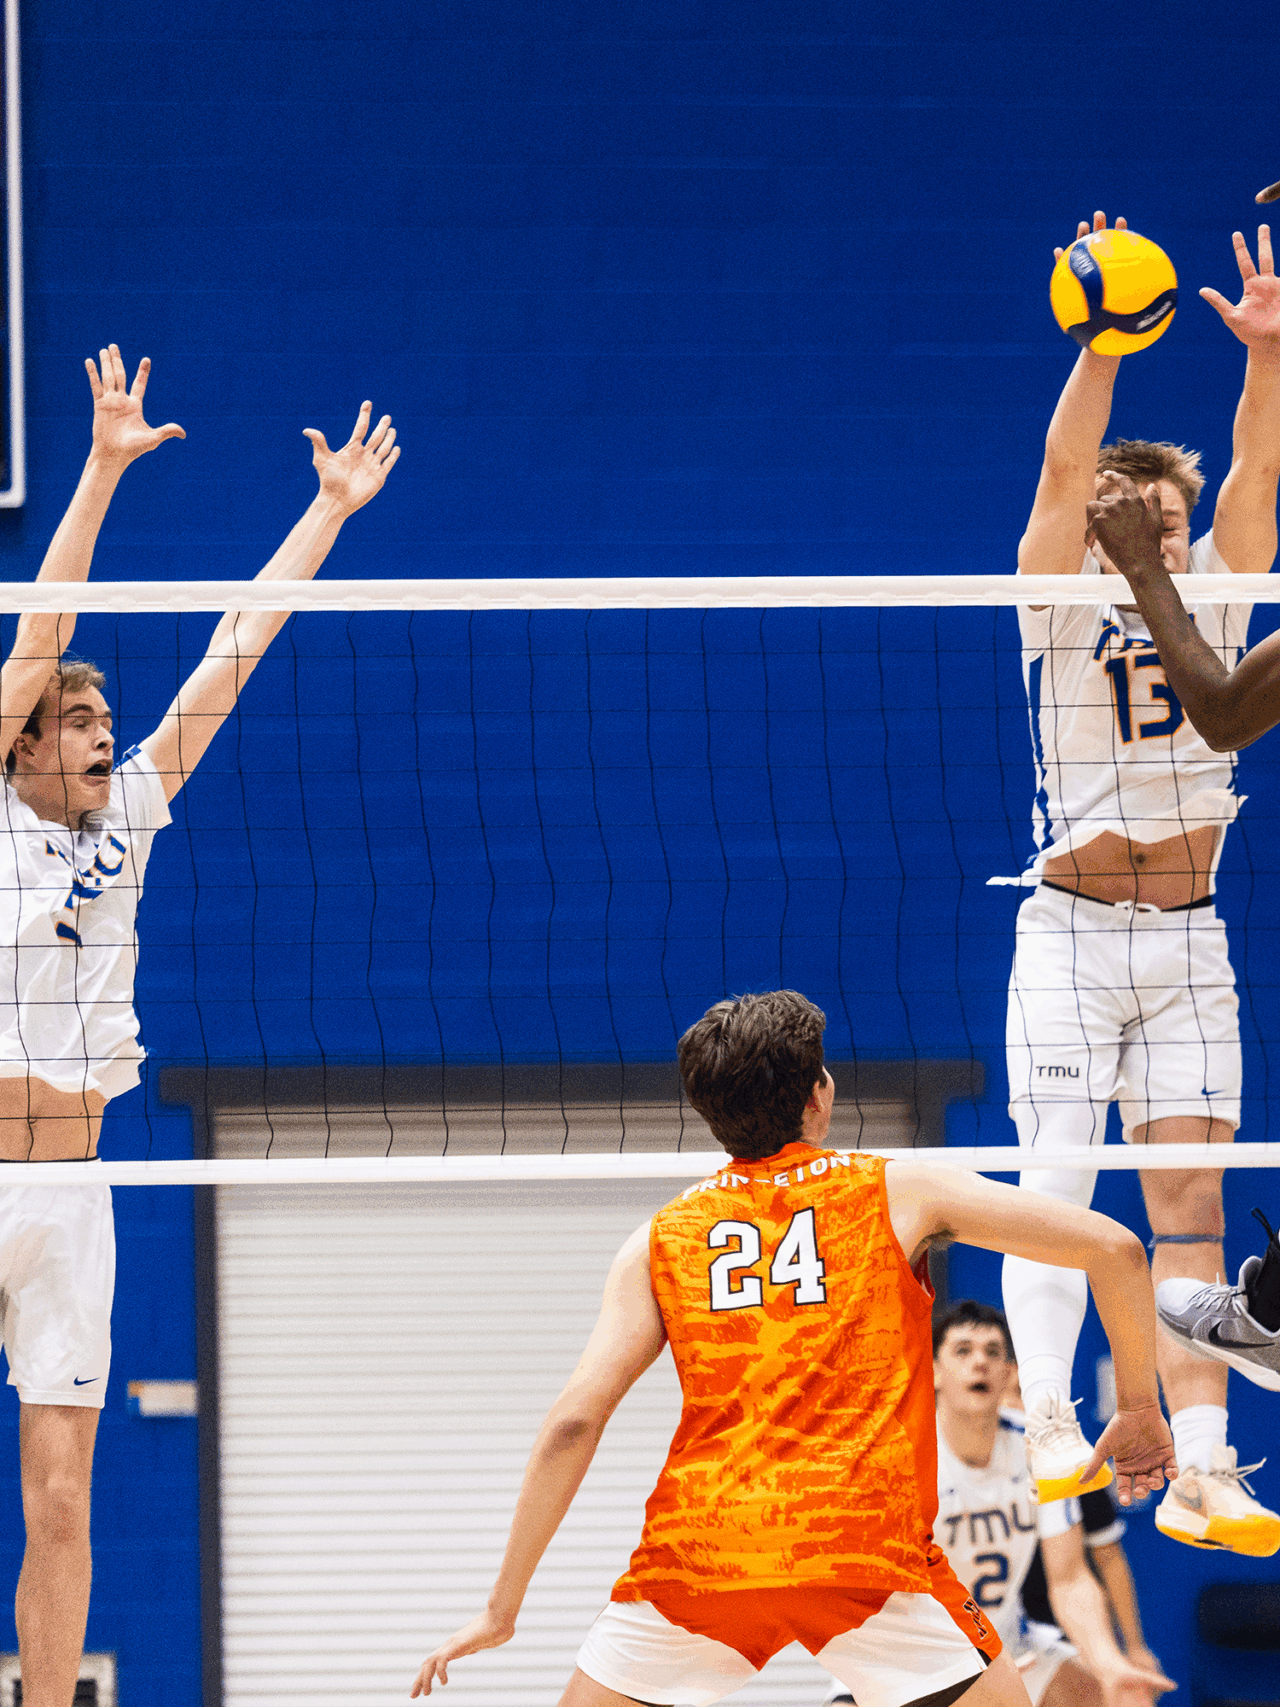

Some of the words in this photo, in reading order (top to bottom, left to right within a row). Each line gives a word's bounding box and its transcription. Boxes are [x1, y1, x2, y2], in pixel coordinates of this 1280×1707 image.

[1104, 652, 1187, 746] 13
[1036, 1066, 1079, 1078] TMU
[707, 1206, 827, 1313] 24
[944, 1502, 1036, 1547] TMU
[972, 1551, 1009, 1608] 2
